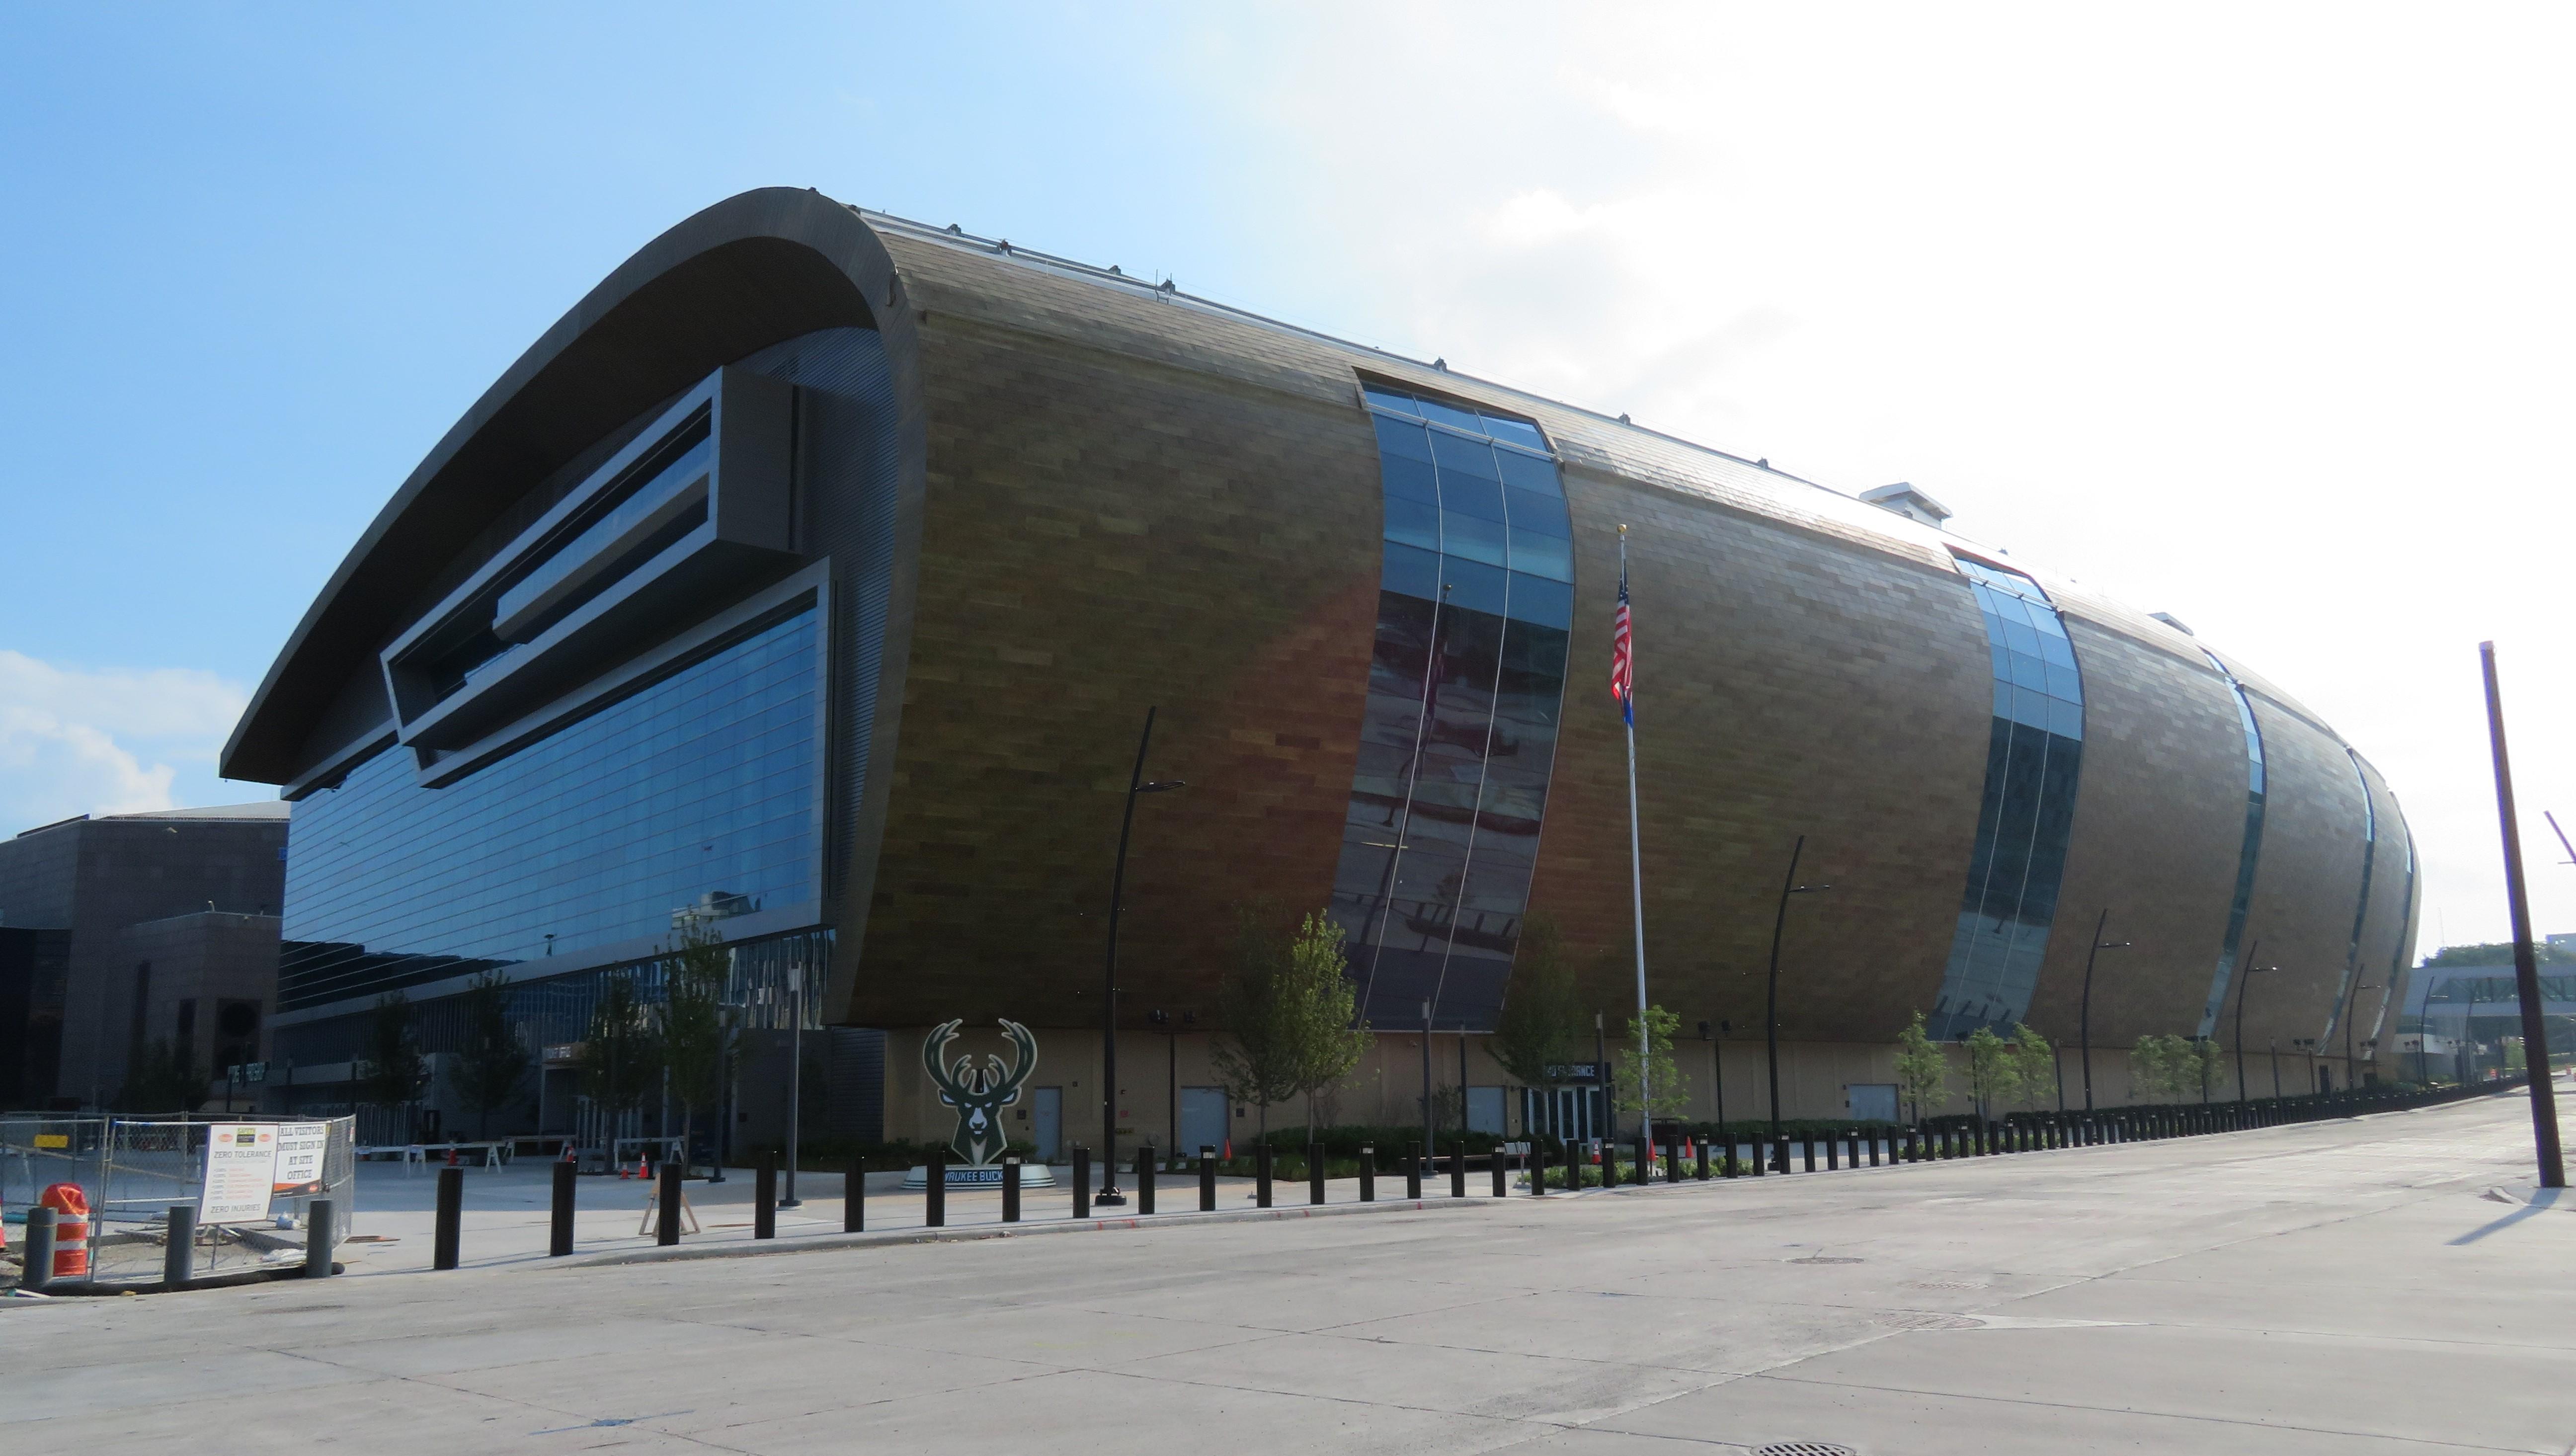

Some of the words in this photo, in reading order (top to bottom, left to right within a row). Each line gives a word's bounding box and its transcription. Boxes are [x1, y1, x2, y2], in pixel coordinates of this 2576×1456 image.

[279, 1128, 293, 1136] ALL
[294, 1126, 324, 1135] VISITORS
[278, 1142, 298, 1151] MUST
[299, 1141, 316, 1150] SIGN
[317, 1140, 324, 1149] IN
[288, 1156, 298, 1165] AT
[299, 1155, 313, 1164] SITE
[287, 1169, 313, 1180] OFFICE
[979, 1171, 1003, 1181] BUCK
[231, 1204, 261, 1213] INJURIES
